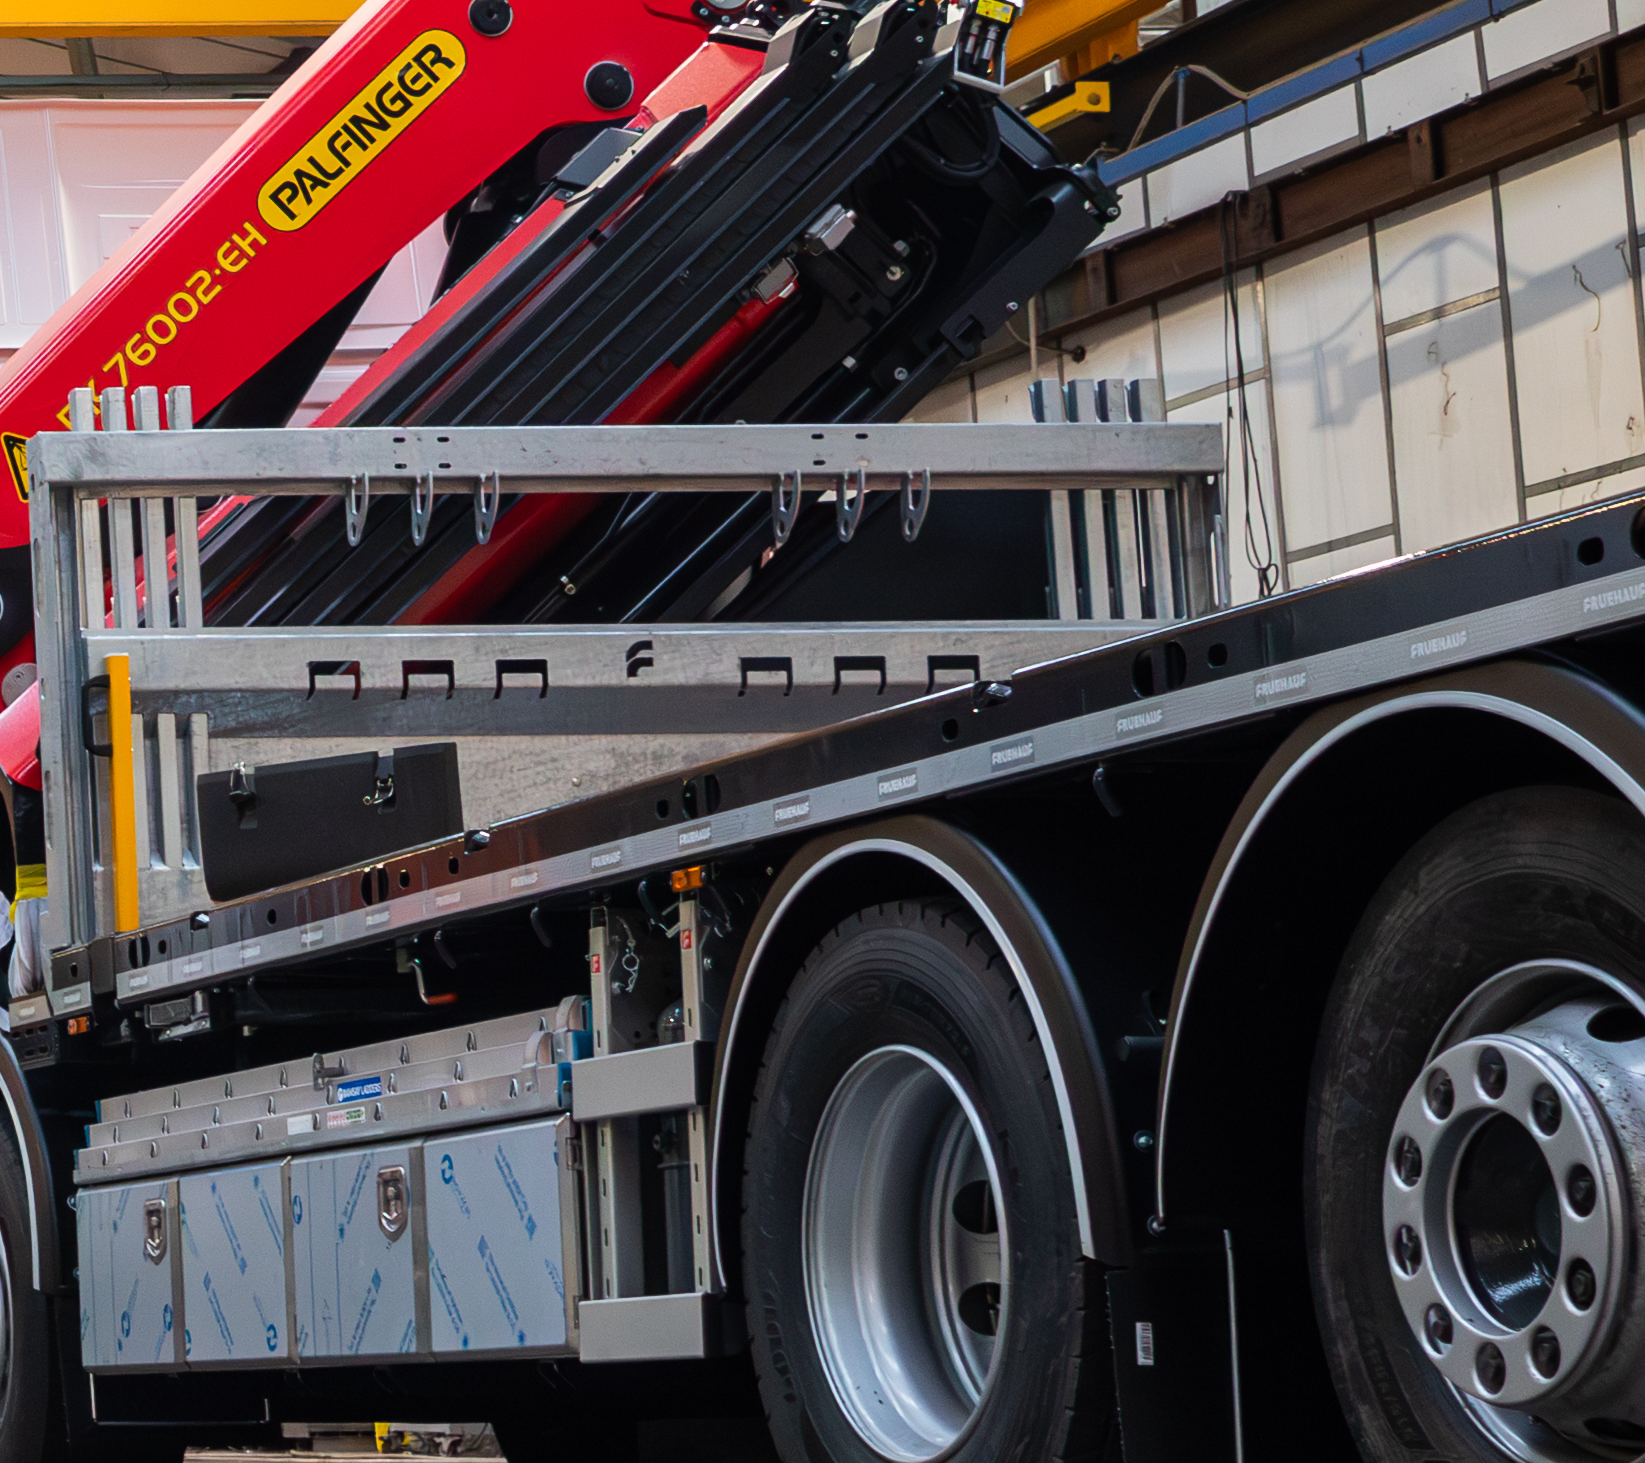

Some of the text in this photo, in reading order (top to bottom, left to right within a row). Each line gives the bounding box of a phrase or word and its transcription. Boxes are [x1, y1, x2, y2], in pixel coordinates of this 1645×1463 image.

[268, 42, 457, 221] PALFINGER
[1410, 631, 1467, 658] FRUEHAUF
[1255, 672, 1307, 699] FRUEHAUF
[1116, 708, 1163, 733] FRUEHAUF
[992, 741, 1034, 766] FRUEHAUF
[879, 773, 917, 796] FRUEHAUF
